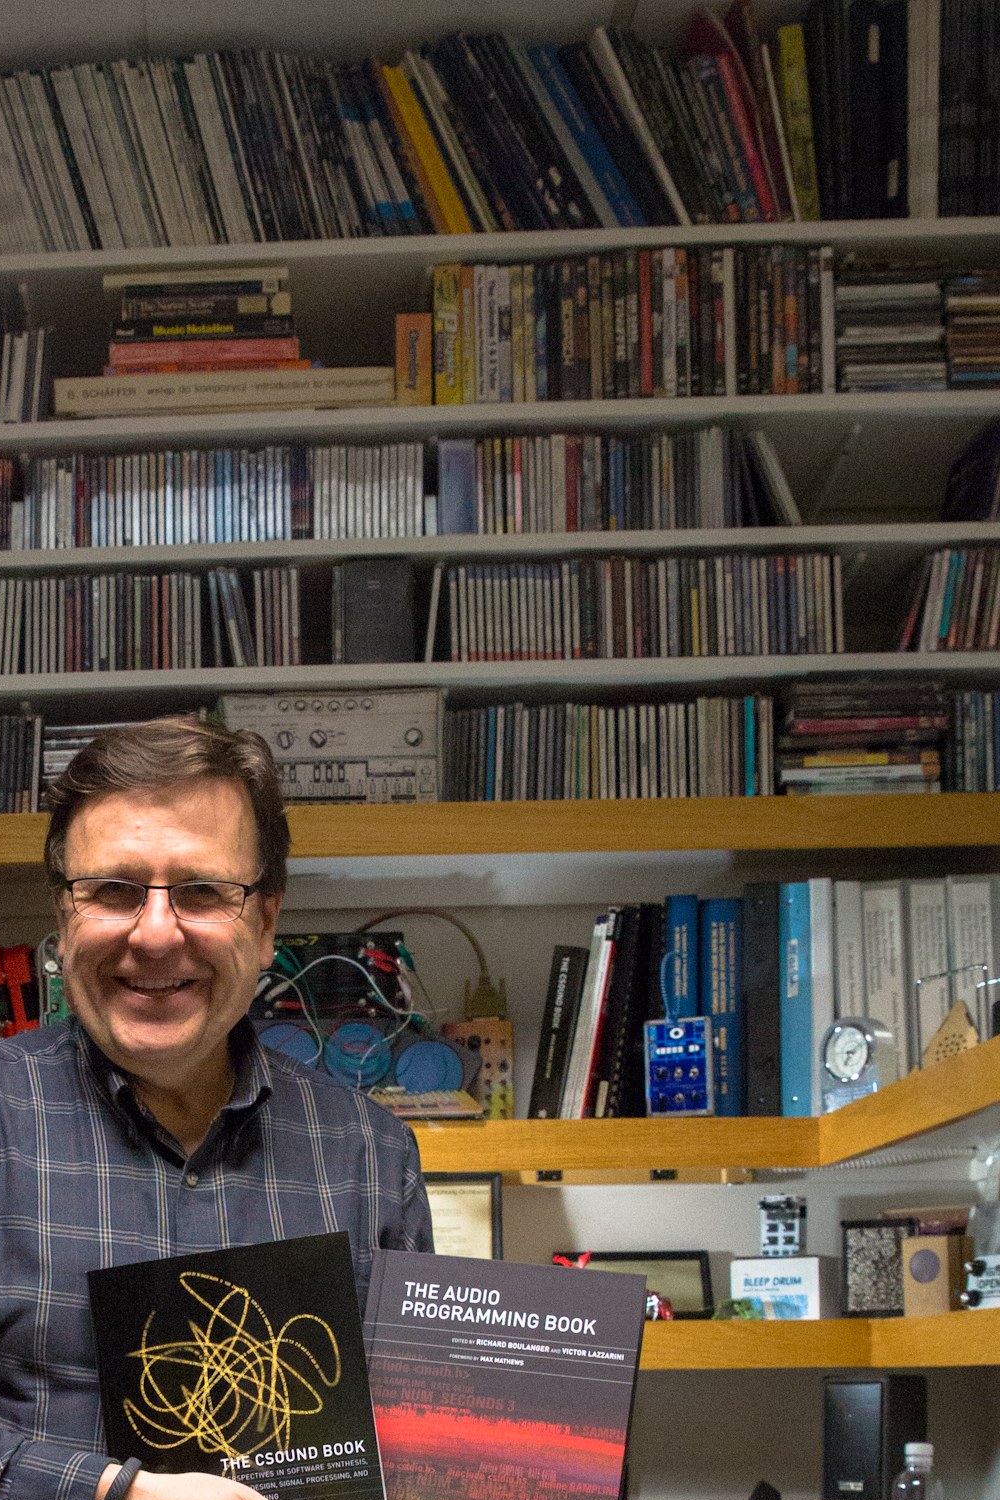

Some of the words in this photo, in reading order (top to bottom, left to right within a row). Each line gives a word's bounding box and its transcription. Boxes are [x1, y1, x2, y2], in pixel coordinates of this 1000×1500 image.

[153, 325, 184, 336] Music
[186, 323, 234, 335] Notation
[561, 957, 570, 972] THE
[556, 973, 568, 1005] CSOUND
[552, 1007, 563, 1029] BOOK
[744, 1277, 770, 1287] BLEEP
[773, 1276, 802, 1286] DRUM
[405, 1281, 441, 1299] THE
[443, 1285, 500, 1306] AUDIO
[401, 1301, 540, 1329] PROGRAMMING
[544, 1315, 597, 1335] BOOK
[449, 1353, 472, 1361] FOREWORD
[494, 1357, 524, 1366] MATHEWS
[476, 1338, 507, 1348] RICHARD
[508, 1341, 550, 1352] BOULANGER
[562, 1347, 587, 1357] VICTOR
[588, 1350, 625, 1361] LAZZARINI
[220, 1455, 250, 1471] THE
[255, 1446, 318, 1466] CSOUND
[323, 1440, 366, 1458] BOOK
[286, 1463, 325, 1474] SOFTWARE
[327, 1458, 368, 1470] SYNTHESIS,
[250, 1482, 278, 1491] DESIGN,
[279, 1479, 304, 1488] SIGNAL
[306, 1473, 352, 1484] PROCESSING,
